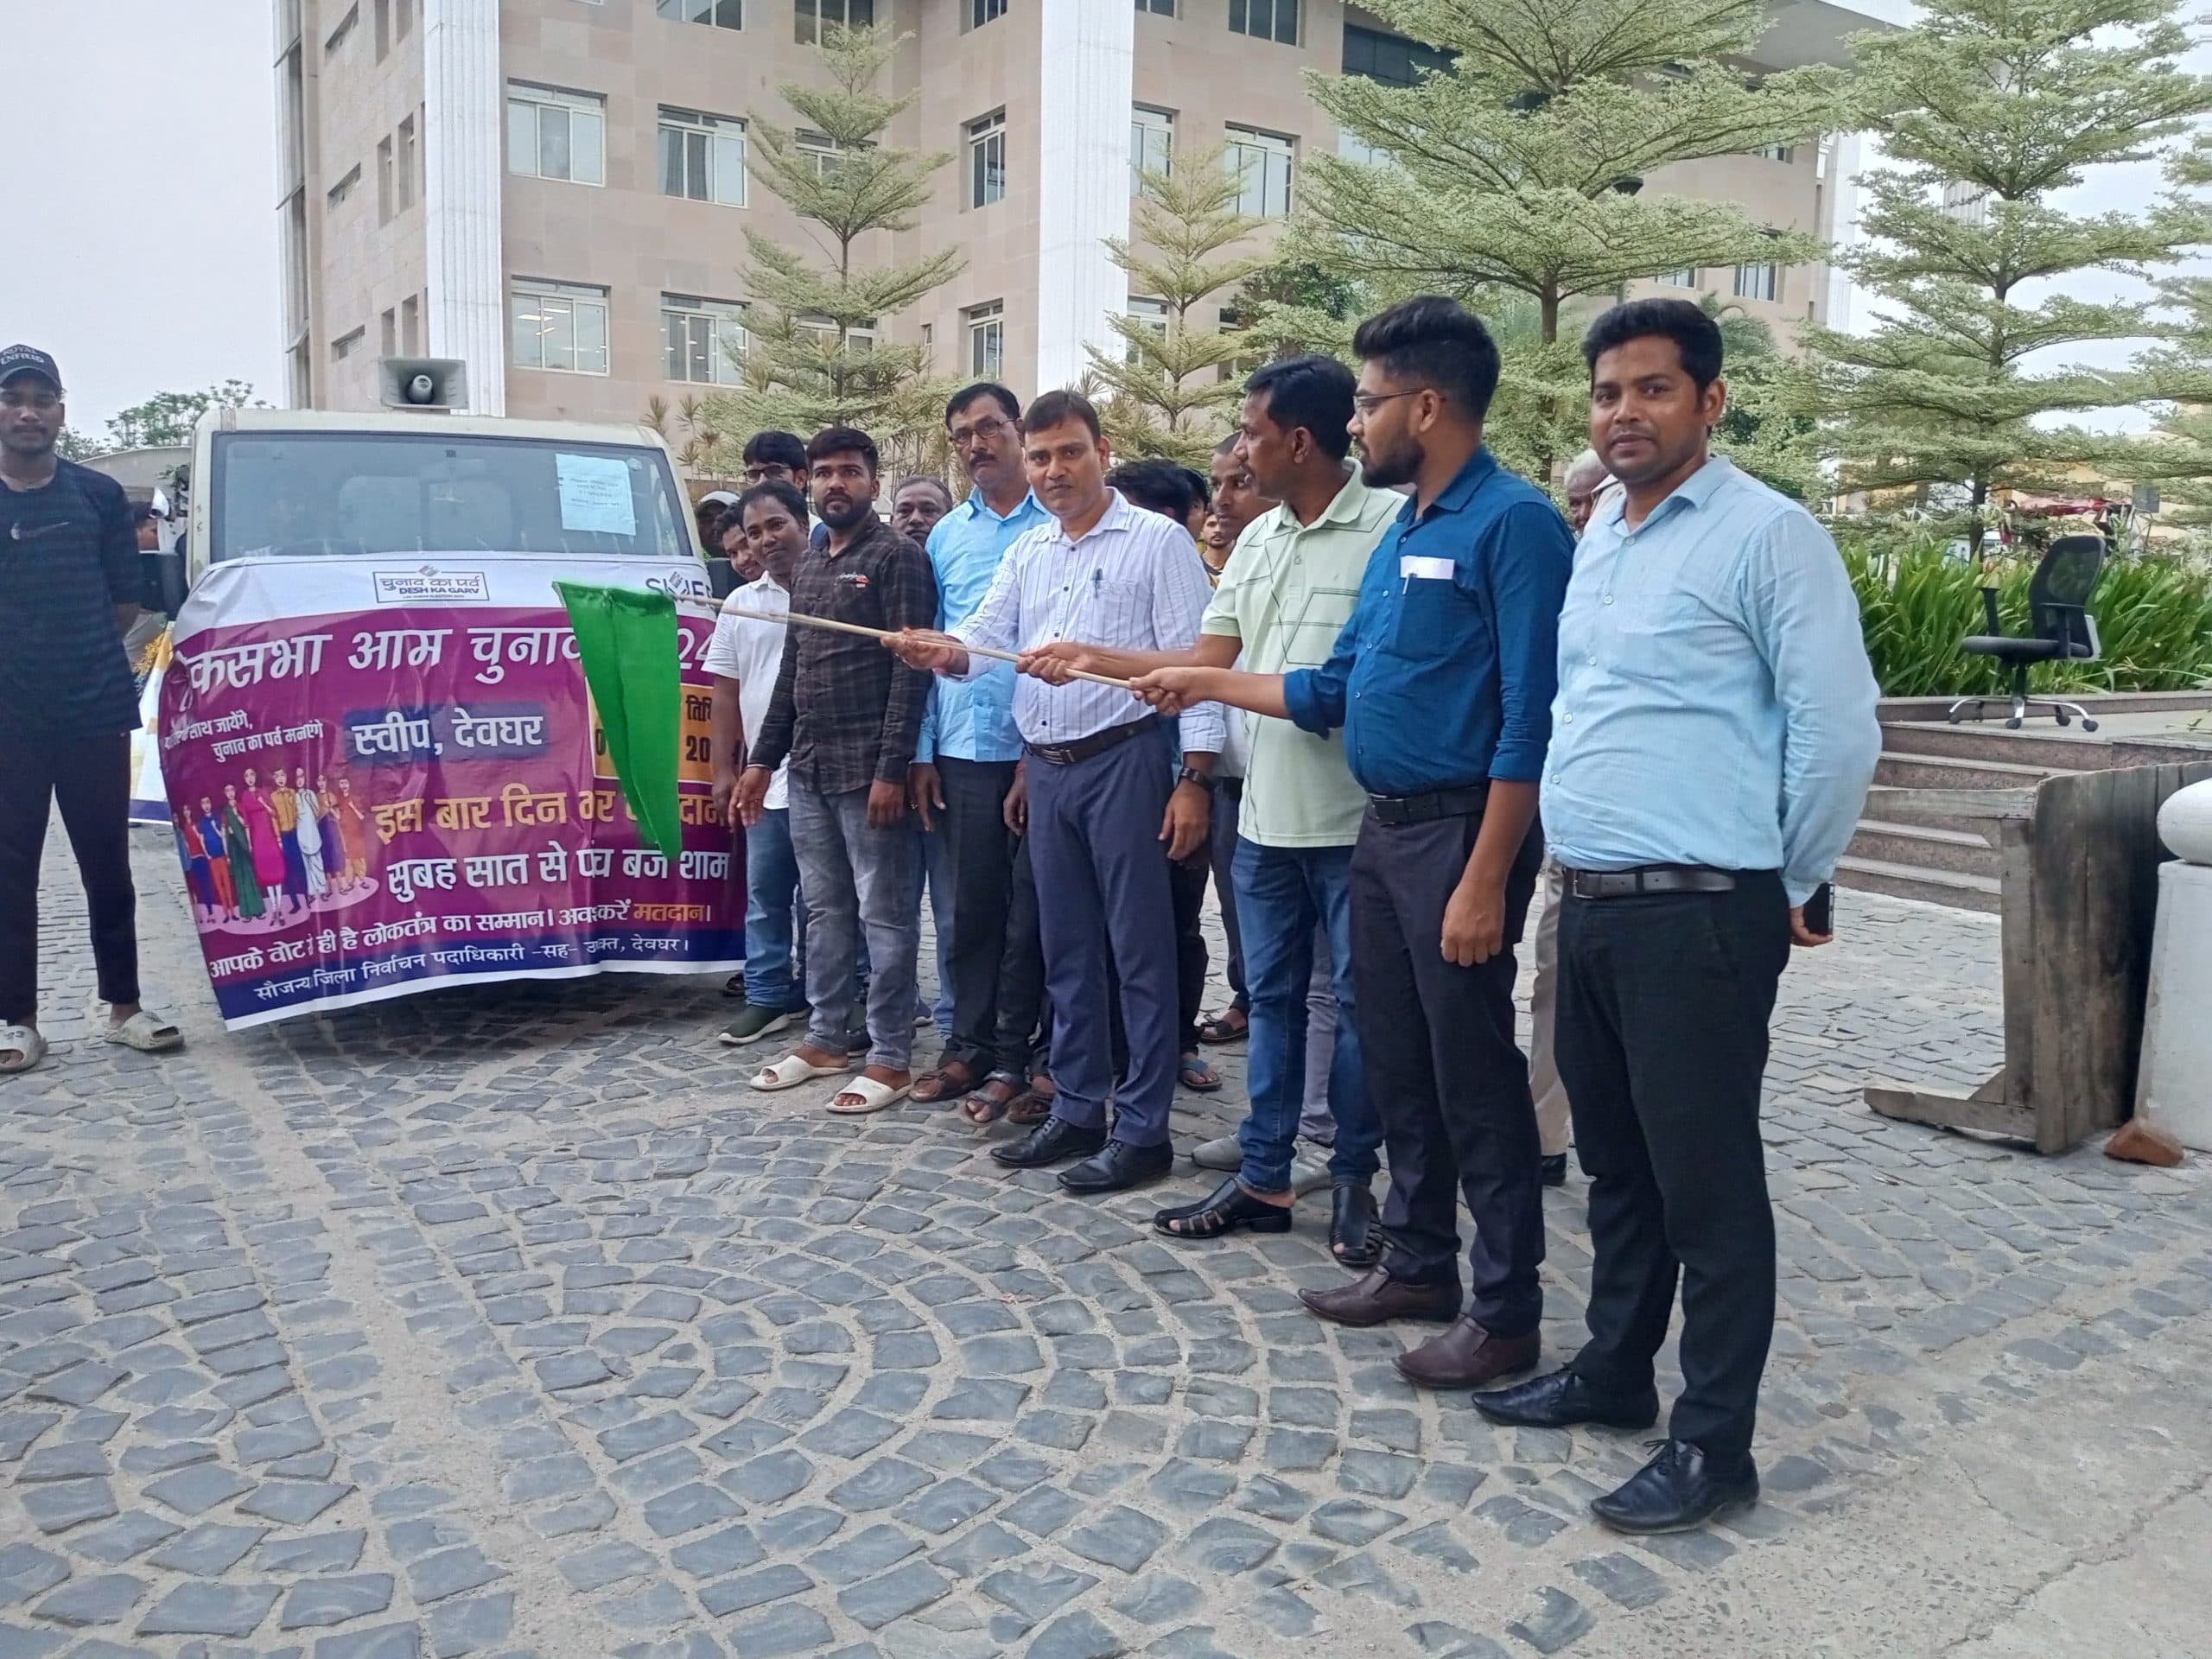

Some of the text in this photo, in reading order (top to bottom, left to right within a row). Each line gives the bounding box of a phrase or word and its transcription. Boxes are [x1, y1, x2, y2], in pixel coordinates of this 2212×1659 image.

[380, 575, 480, 591] चुनाव का पर्व
[347, 628, 453, 671] आम
[211, 736, 246, 762] चुनाव
[247, 734, 263, 750] का
[261, 726, 283, 747] पर्व
[351, 707, 543, 755] स्वीप, देवघर
[371, 798, 424, 845] इस
[434, 797, 493, 830] बार
[499, 783, 568, 827] दिन
[386, 858, 457, 903] सुबह
[463, 853, 530, 887] सात
[537, 840, 568, 882] से
[679, 850, 731, 880] शाम
[209, 947, 264, 978] आपके
[267, 940, 307, 963] वोट
[316, 928, 337, 954] ही
[340, 925, 359, 950] है
[361, 911, 437, 947] लोकतंत्र
[442, 914, 471, 932] का
[313, 968, 356, 988] जिला
[360, 955, 427, 980] निर्वाचन
[430, 942, 525, 965] पदाधिकारी
